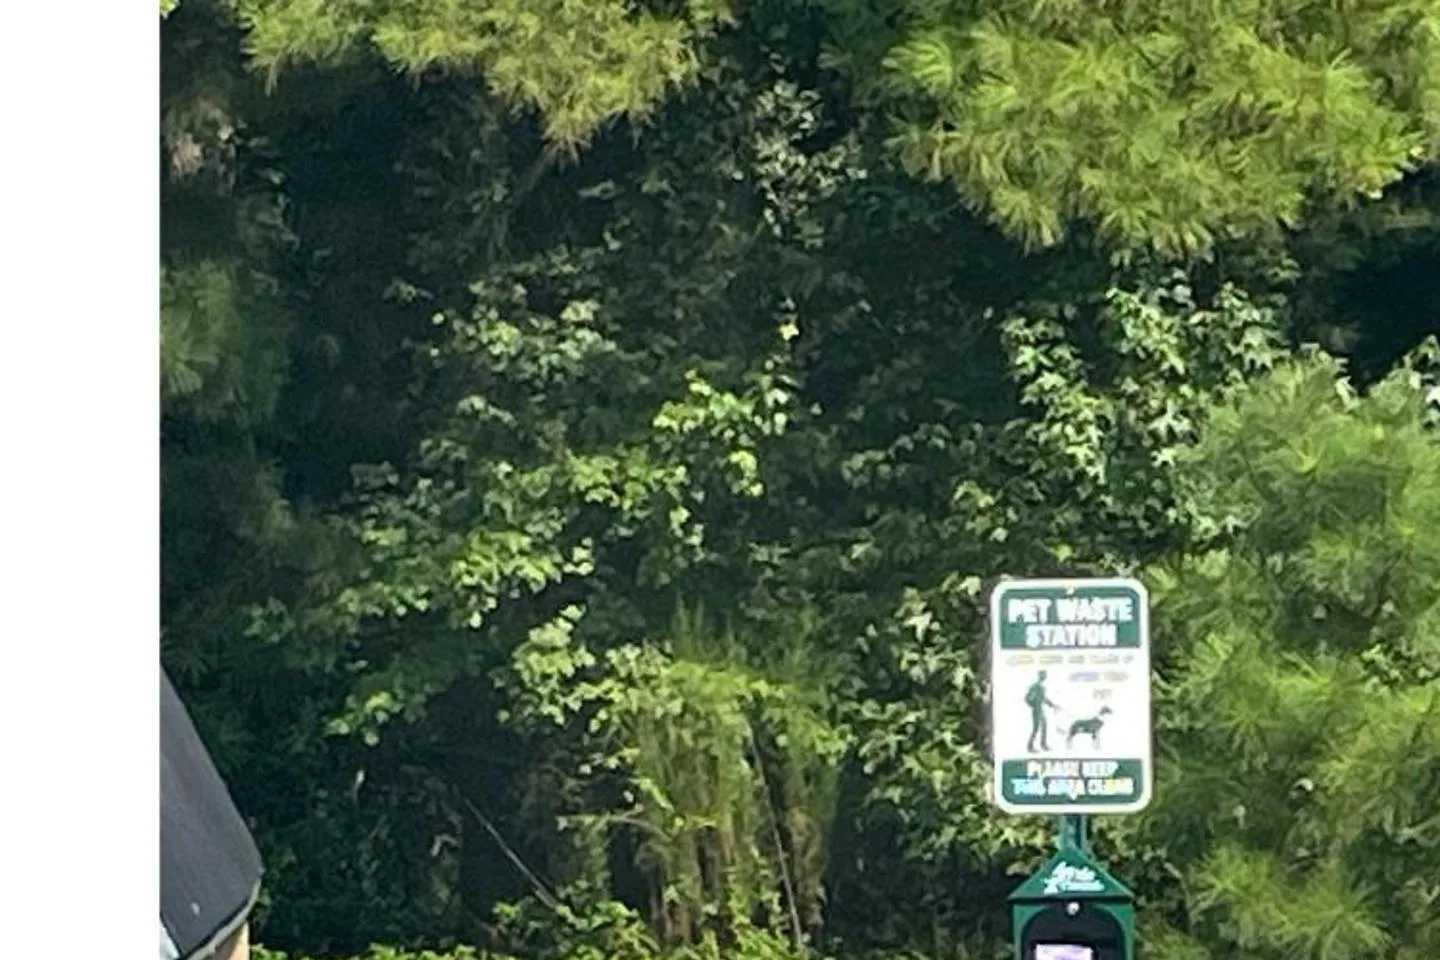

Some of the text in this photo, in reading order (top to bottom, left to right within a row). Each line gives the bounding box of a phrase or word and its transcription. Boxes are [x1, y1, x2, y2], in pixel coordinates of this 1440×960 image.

[1008, 597, 1133, 622] PET WASTE
[1026, 624, 1117, 648] STATION
